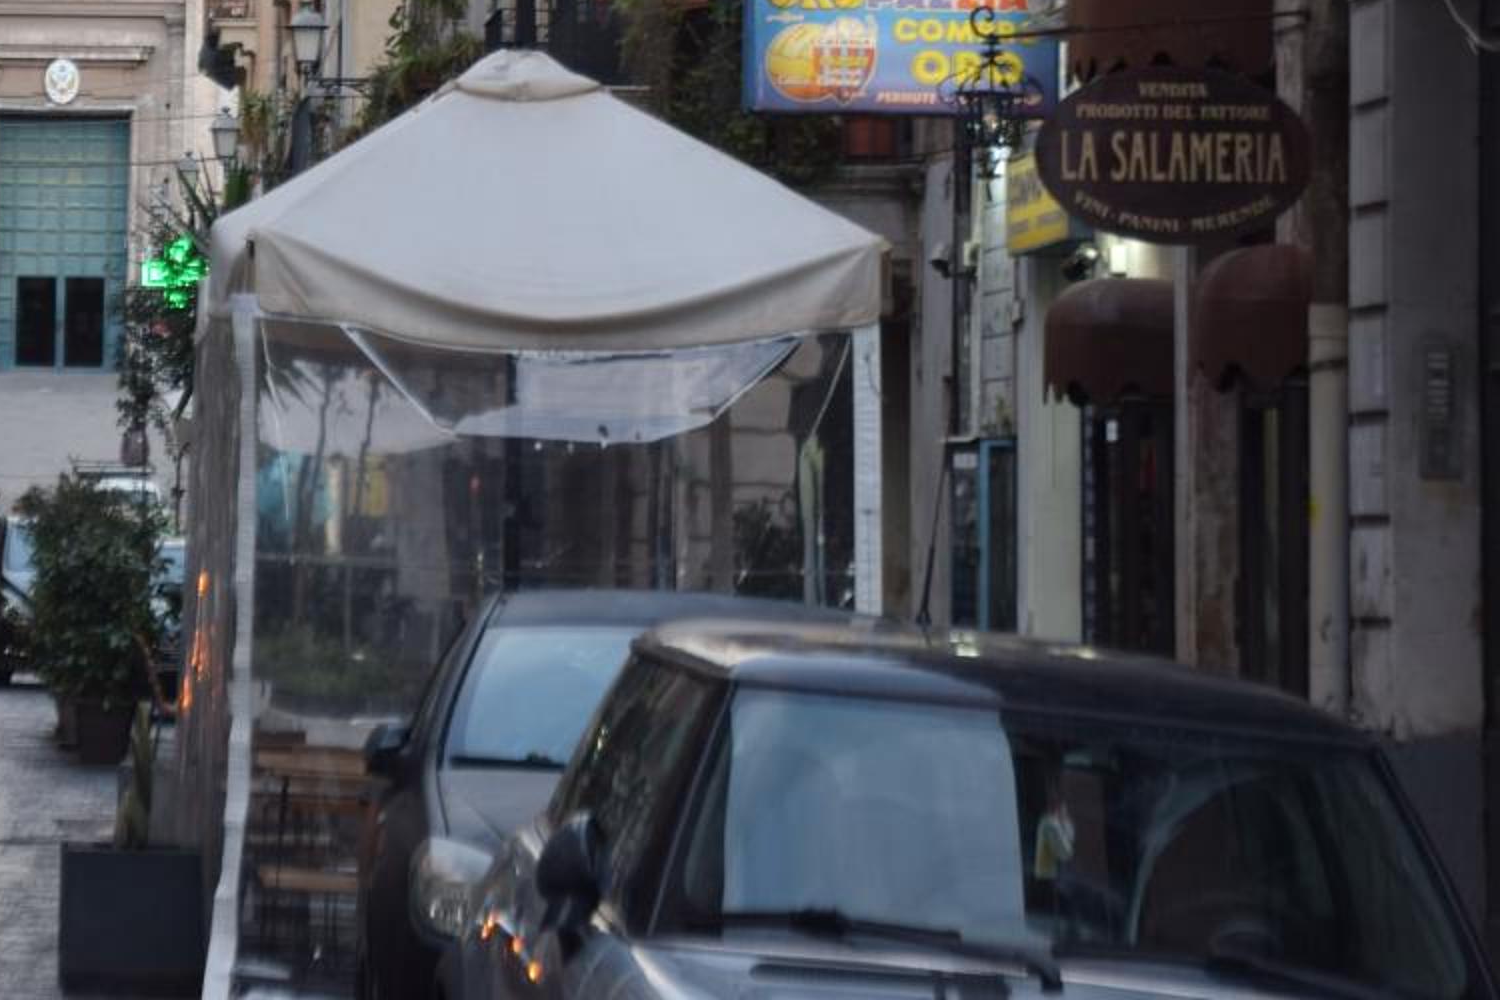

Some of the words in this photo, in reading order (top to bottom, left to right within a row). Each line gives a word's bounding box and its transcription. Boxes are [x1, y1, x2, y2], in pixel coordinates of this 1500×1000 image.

[912, 50, 1024, 86] ORO
[1075, 103, 1158, 120] PRODOTTI
[1162, 104, 1194, 120] DEL
[1060, 130, 1099, 182] LA
[1110, 131, 1287, 184] SALAMERIA
